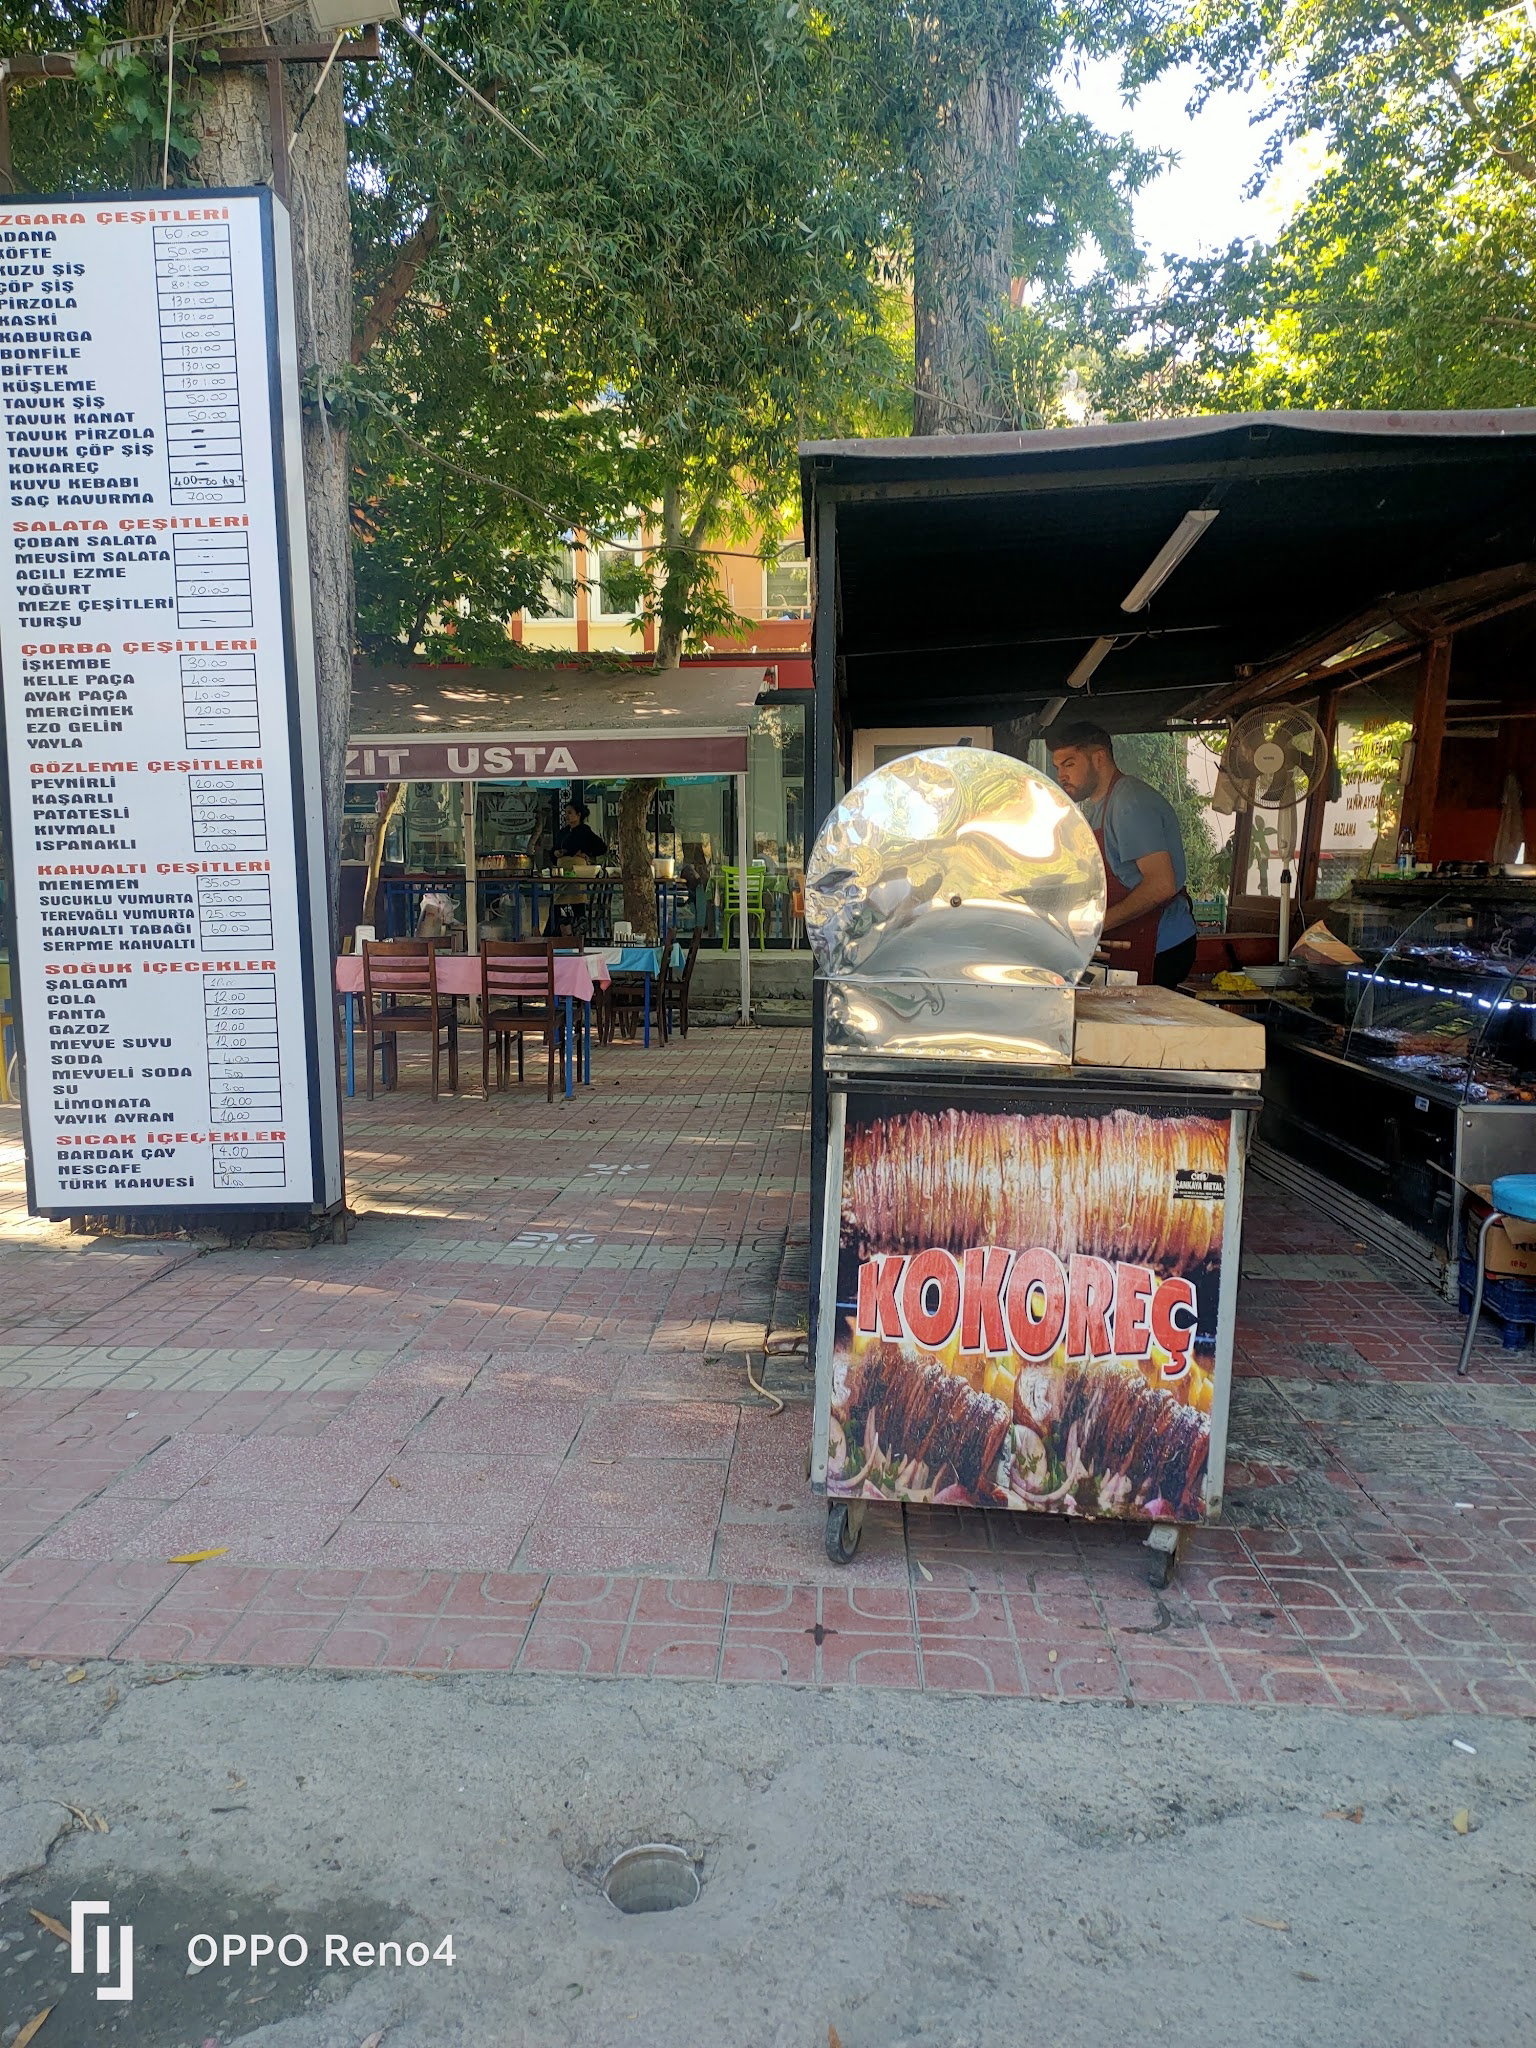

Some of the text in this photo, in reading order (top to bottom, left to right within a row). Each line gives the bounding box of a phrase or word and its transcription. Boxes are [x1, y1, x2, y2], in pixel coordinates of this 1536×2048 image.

[96, 207, 229, 225] ÇEŞİTLERİ
[0, 230, 56, 242] DANA
[52, 261, 85, 277] ŞİŞ
[41, 278, 74, 294] ŞİŞ
[0, 296, 77, 309] PİRZOLA
[0, 330, 92, 343] KABURGA
[0, 345, 80, 359] BONFİLE
[1, 363, 67, 375] BİFTEK
[2, 380, 96, 394] KÜŞLEME
[3, 394, 105, 409] TAVUK ŞİŞ
[4, 411, 135, 425] TAVUK KANAT
[5, 427, 154, 441] TAVUK PİRZOLA
[7, 444, 153, 458] TAVUK ÇÖP ŞİŞ
[8, 462, 98, 474] KOKAREÇ
[9, 477, 138, 490] KUYU KEBABI
[10, 493, 153, 508] SAÇ KAVURMA
[12, 514, 249, 532] SALATA ÇEŞİTLERİ
[13, 535, 156, 550] ÇOBAN SALATA
[14, 550, 170, 564] MEVSİM SALATA
[16, 567, 126, 580] ACILI EZME
[15, 582, 91, 595] YOĞURT
[18, 597, 174, 612] MEZE ÇEŞİTLERİ
[20, 616, 81, 628] TURŞU
[21, 639, 256, 656] ÇORBA ÇEŞİTLERİ
[22, 658, 110, 672] İŞKEMBE
[23, 674, 134, 686] KELLE PAÇA
[24, 690, 127, 702] AYAK PAÇA
[25, 704, 133, 717] MERCİMEK
[26, 719, 122, 733] EZO GELİN
[26, 738, 82, 748] YAYLA
[29, 759, 263, 773] GÖZLEME ÇEŞİTLERİ
[447, 746, 579, 774] USTA
[30, 775, 115, 788] PEYNİRLİ
[32, 793, 113, 806] KAŞARLI
[33, 806, 129, 820] PATATESLİ
[34, 824, 115, 835] KIYMALI
[35, 839, 136, 850] ISPANAKLI
[37, 859, 270, 875] KAHVALTI ÇEŞİTLERİ
[38, 879, 138, 890] MENEMEN
[39, 893, 193, 906] SUCUKLU YUMURTA
[40, 908, 194, 921] TEREYAĞLI YUMURTA
[41, 921, 191, 936] KAHVALTI TABAĞI
[43, 939, 195, 951] SERPME KAHVALTI
[45, 960, 276, 974] SOĞUK İÇECEKLER
[45, 979, 127, 991] ŞALGAM
[46, 994, 95, 1004] COLA
[214, 990, 246, 1003] 12.00
[48, 1009, 105, 1019] FANTA
[49, 1024, 109, 1035] GAZOZ
[214, 1021, 245, 1032] 12.00
[50, 1037, 171, 1049] MEYVE SUYU
[51, 1054, 102, 1064] SODA
[52, 1066, 192, 1079] MEYVELİ SODA
[52, 1084, 78, 1094] SU
[54, 1097, 150, 1109] LİMONATA
[54, 1112, 174, 1124] YAYIK AYRAN
[56, 1134, 136, 1145] SICAK
[57, 1148, 175, 1160] BARDAK ÇAY
[58, 1163, 141, 1175] NESCAFE
[58, 1175, 194, 1189] TÜRK KAHVESİ
[1203, 1181, 1224, 1192] METAL
[857, 1246, 1197, 1379] KOKOREÇ
